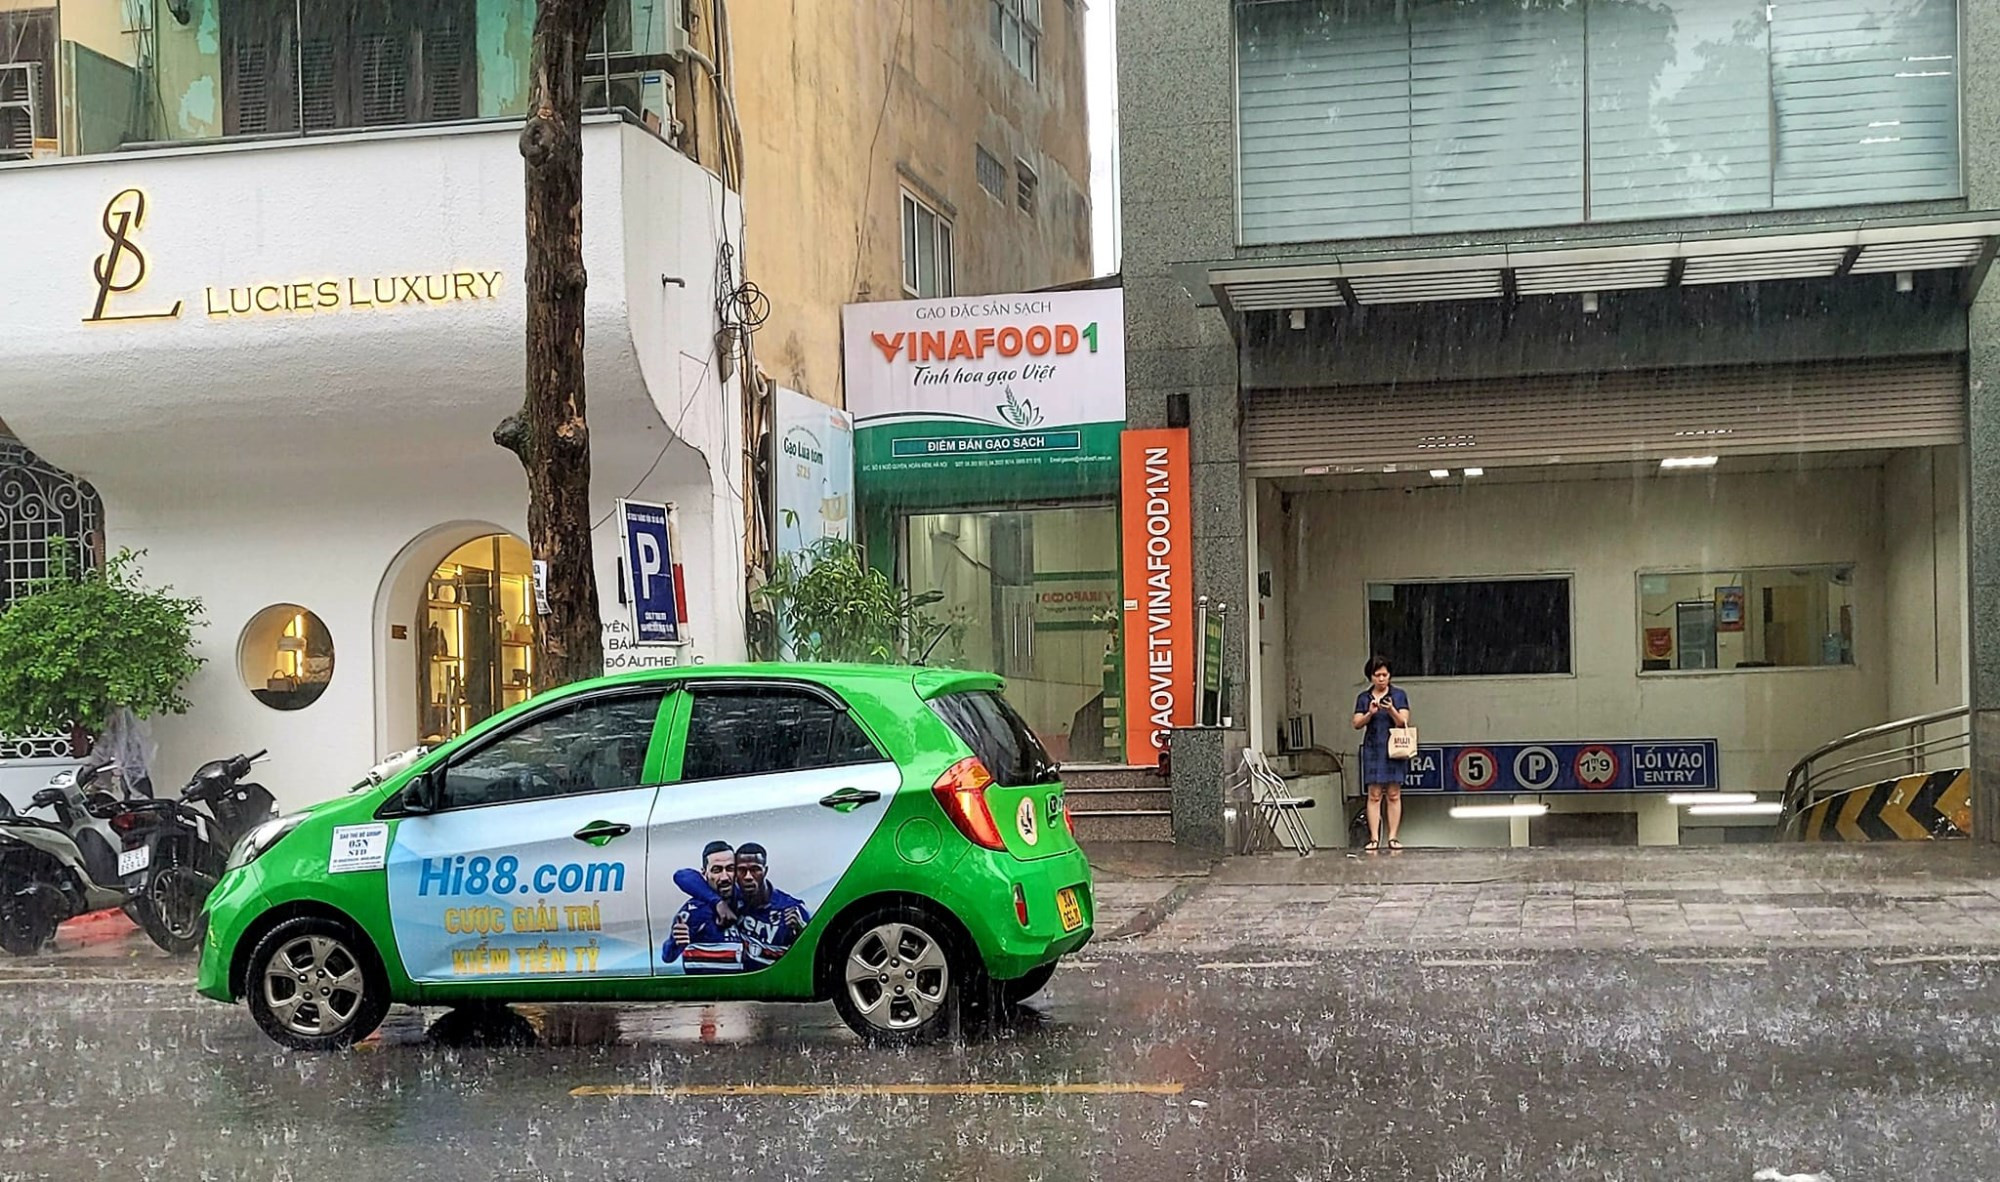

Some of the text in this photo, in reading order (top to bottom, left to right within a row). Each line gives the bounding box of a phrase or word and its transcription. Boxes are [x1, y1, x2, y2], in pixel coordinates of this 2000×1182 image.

[206, 271, 502, 315] LUCIES LUXURY
[915, 300, 1051, 321] GẠO ĐẶC SẢN SẠCH
[871, 322, 1099, 363] VINAFOOD1
[953, 367, 982, 384] hoa
[985, 369, 1018, 388] gạo
[1022, 364, 1057, 383] Việt
[958, 438, 982, 450] BÁN
[985, 438, 1010, 451] GẠO
[1012, 436, 1045, 450] SẠCH
[636, 532, 661, 599] P
[603, 620, 630, 633] YÊN
[1410, 756, 1436, 771] RA
[1468, 756, 1484, 781] 5
[1528, 755, 1546, 780] P
[1635, 747, 1702, 769] LỐI VÀO
[1644, 770, 1696, 783] ENTRY
[418, 855, 625, 896] Hi88.com
[445, 898, 601, 939] CƯỢC GIẢI TRÍ
